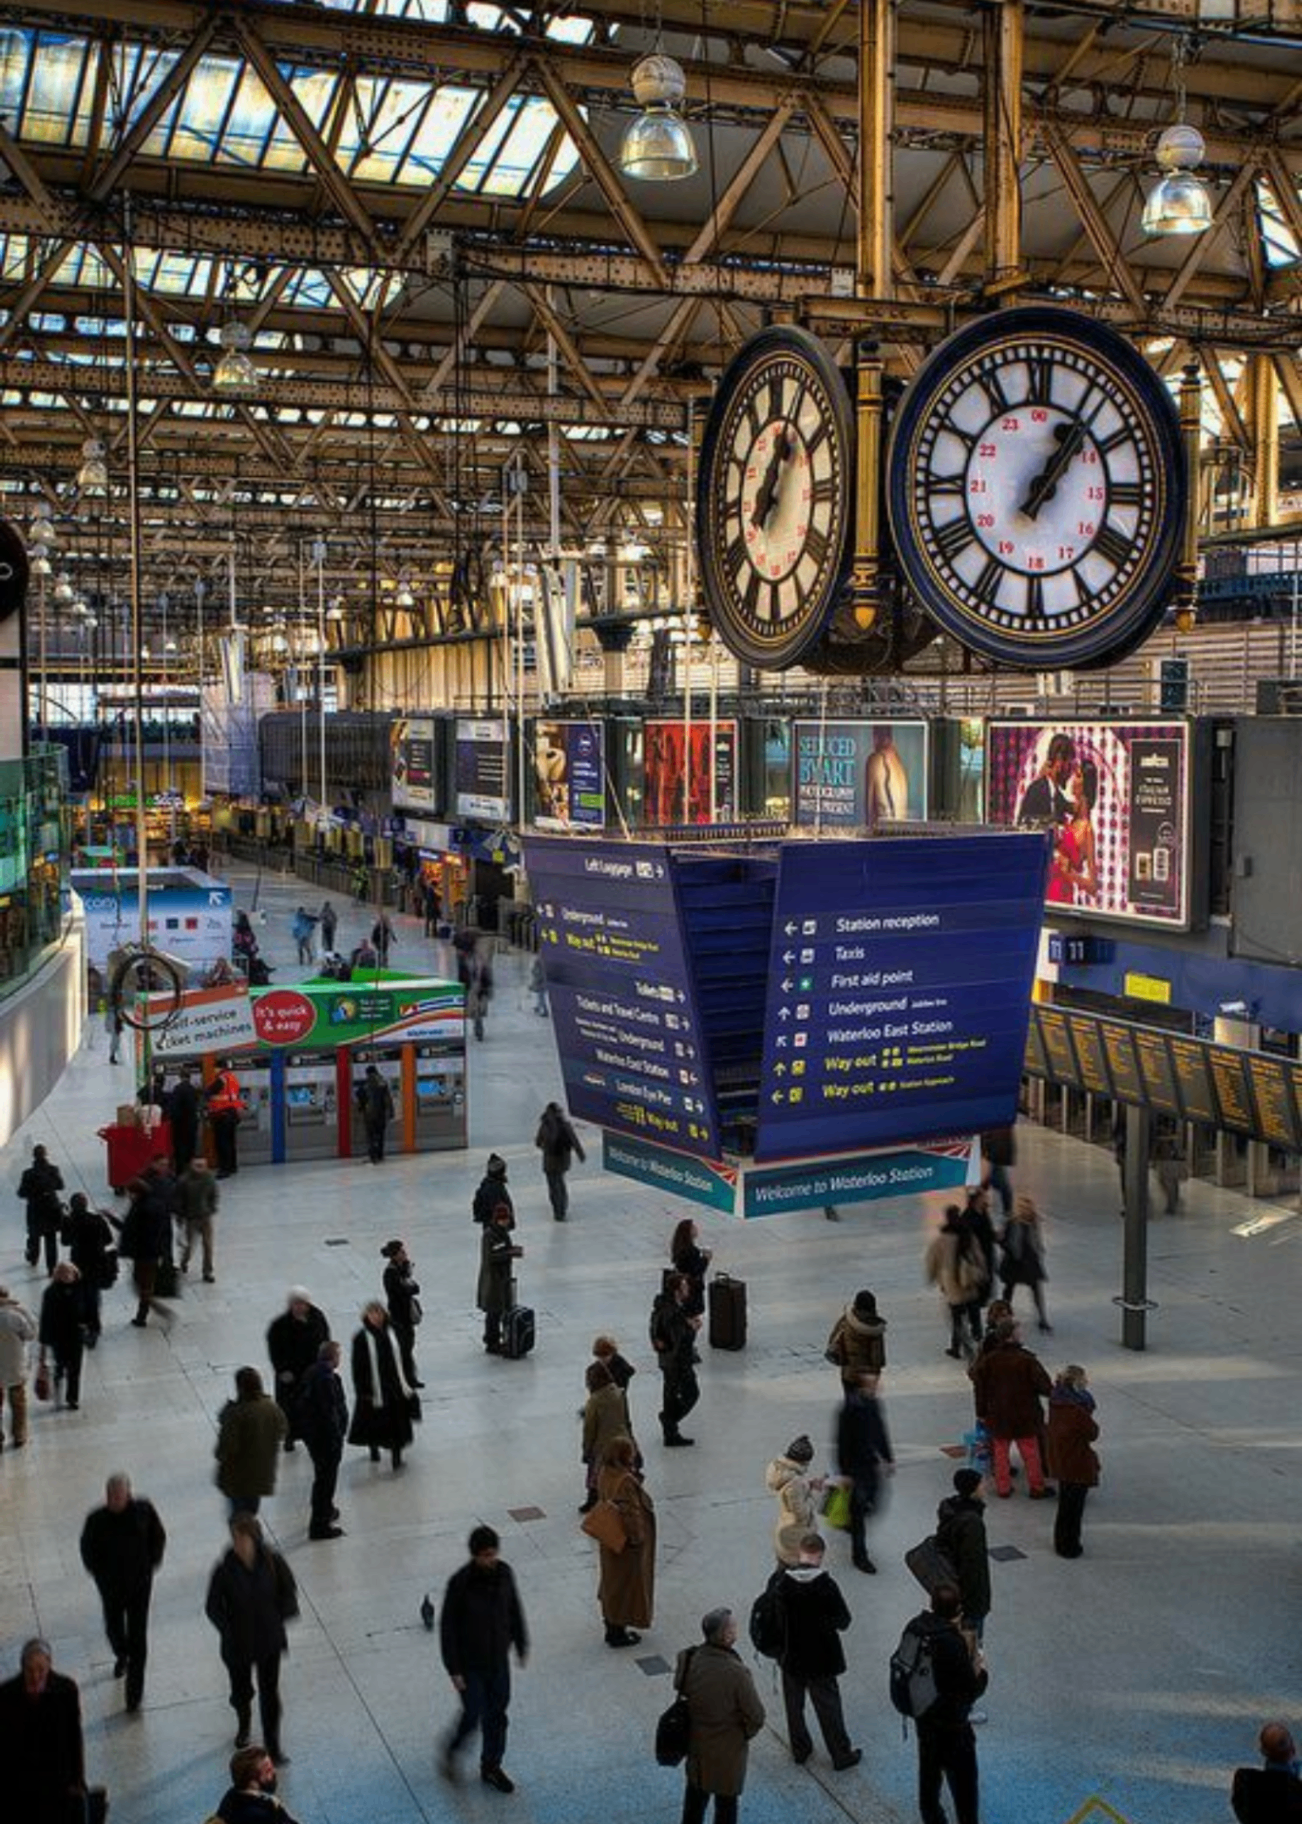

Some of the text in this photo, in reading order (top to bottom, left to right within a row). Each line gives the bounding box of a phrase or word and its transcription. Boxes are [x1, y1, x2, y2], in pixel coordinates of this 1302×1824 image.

[1002, 418, 1018, 430] 23
[980, 443, 995, 457] 22
[970, 479, 985, 493] 21
[1088, 487, 1104, 500] 15
[978, 513, 995, 527] 20
[1079, 521, 1094, 535] 16
[999, 541, 1015, 554] 19
[1059, 546, 1074, 559] 17
[1028, 556, 1044, 569] 18
[836, 914, 939, 933] Station reception
[836, 946, 865, 960] Taxis
[1069, 941, 1084, 961] 11
[831, 970, 913, 988] First aid point
[256, 1004, 307, 1018] It's quick
[829, 997, 908, 1017] Underground
[195, 1023, 252, 1042] machines
[264, 1021, 301, 1033] & easy
[827, 1020, 953, 1043] Waterloo East Station
[824, 1054, 877, 1072] Way out
[822, 1081, 874, 1099] Way out
[685, 1170, 714, 1192] Station
[755, 1165, 934, 1201] Welcome to Waterloo Station
